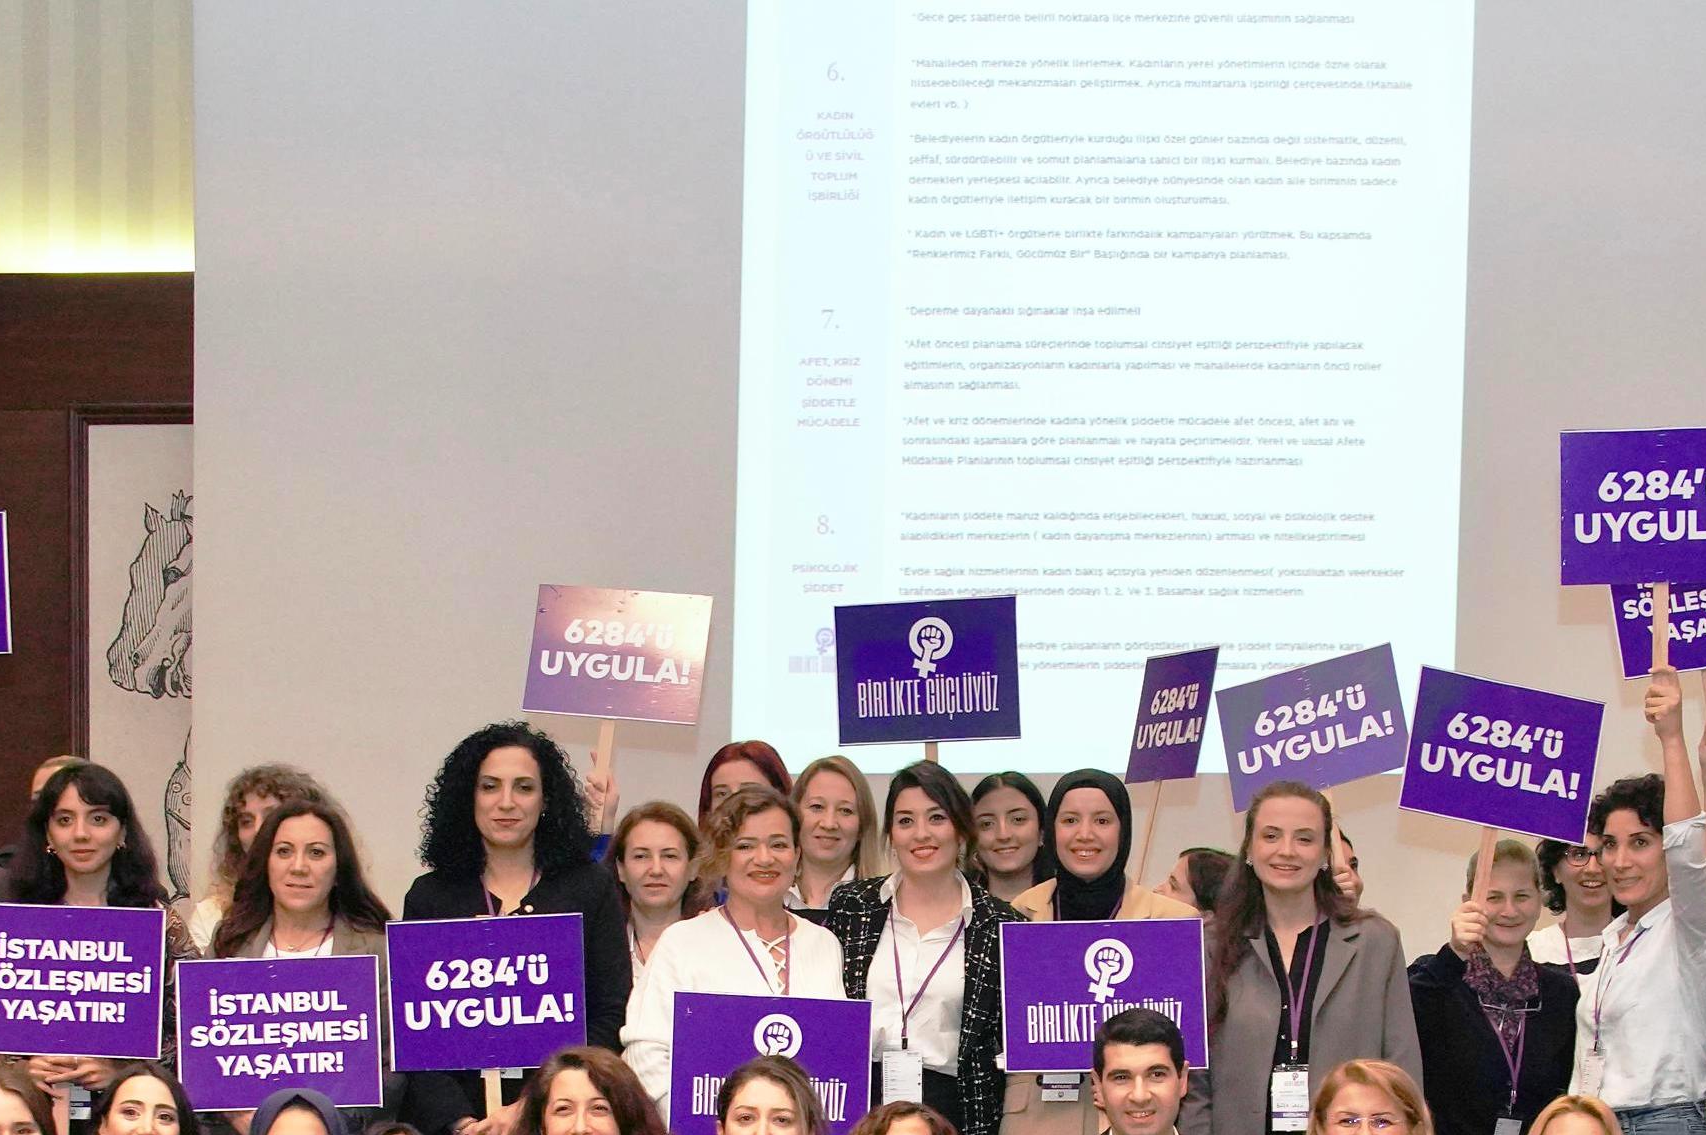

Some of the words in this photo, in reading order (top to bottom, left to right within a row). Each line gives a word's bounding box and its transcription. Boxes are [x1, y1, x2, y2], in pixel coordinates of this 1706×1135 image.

[563, 616, 674, 650] 6284'Ü
[539, 649, 692, 687] UYGULA!
[857, 676, 922, 719] BİRLİKTE
[925, 672, 1000, 721] GÜÇLÜYÜZ
[1150, 682, 1200, 716] 6284'Ü
[1254, 683, 1366, 737] 6284'Ü
[1136, 716, 1203, 750] UYGULA!
[1237, 705, 1395, 775] UYGULA!
[1446, 711, 1564, 759] 6284'Ü
[1420, 742, 1581, 801] UYGULA!
[425, 953, 549, 991] 6284'Ü
[0, 998, 126, 1025] YAŞATIR!
[209, 988, 348, 1016] İSTANBUL
[404, 992, 575, 1031] UYGULA!
[190, 1012, 368, 1048] SÖZLEŞMESİ
[215, 1051, 344, 1080] YAŞATIR!
